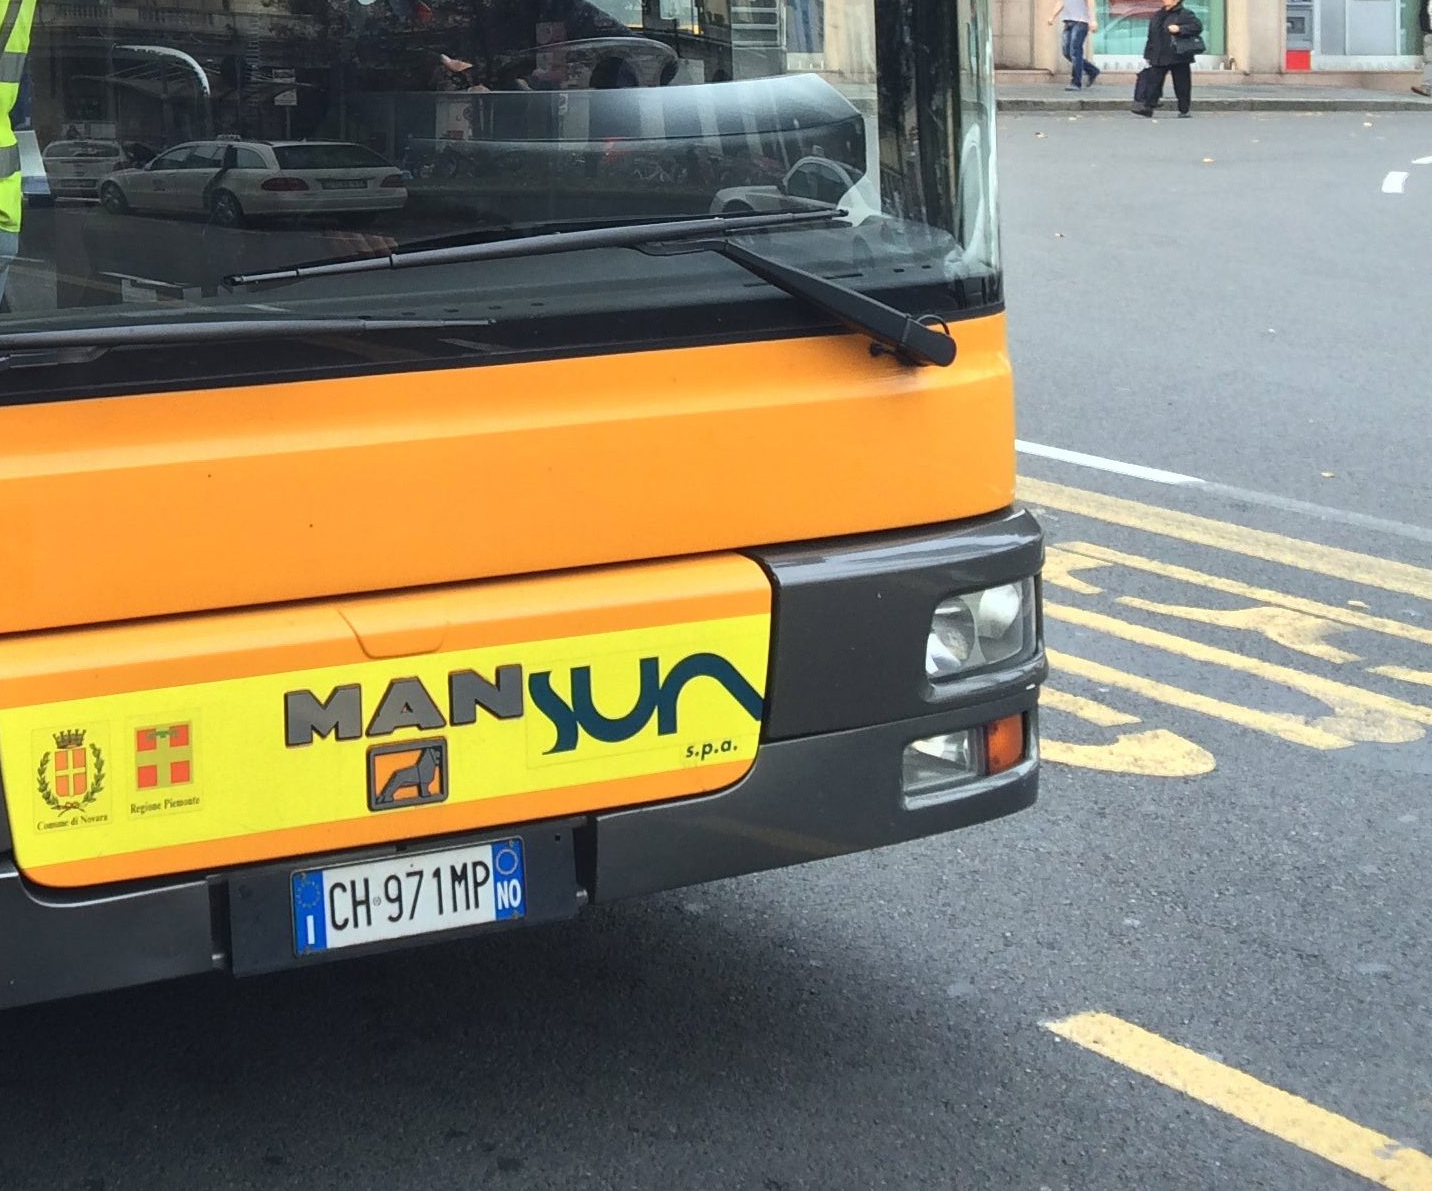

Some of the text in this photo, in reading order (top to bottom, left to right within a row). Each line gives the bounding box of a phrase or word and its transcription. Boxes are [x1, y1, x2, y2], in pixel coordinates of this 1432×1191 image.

[283, 663, 524, 749] MAN
[684, 737, 739, 761] s.p.a.
[130, 796, 200, 815] Regione Piemonte
[36, 813, 108, 831] Comune di Novara
[496, 878, 522, 911] NO
